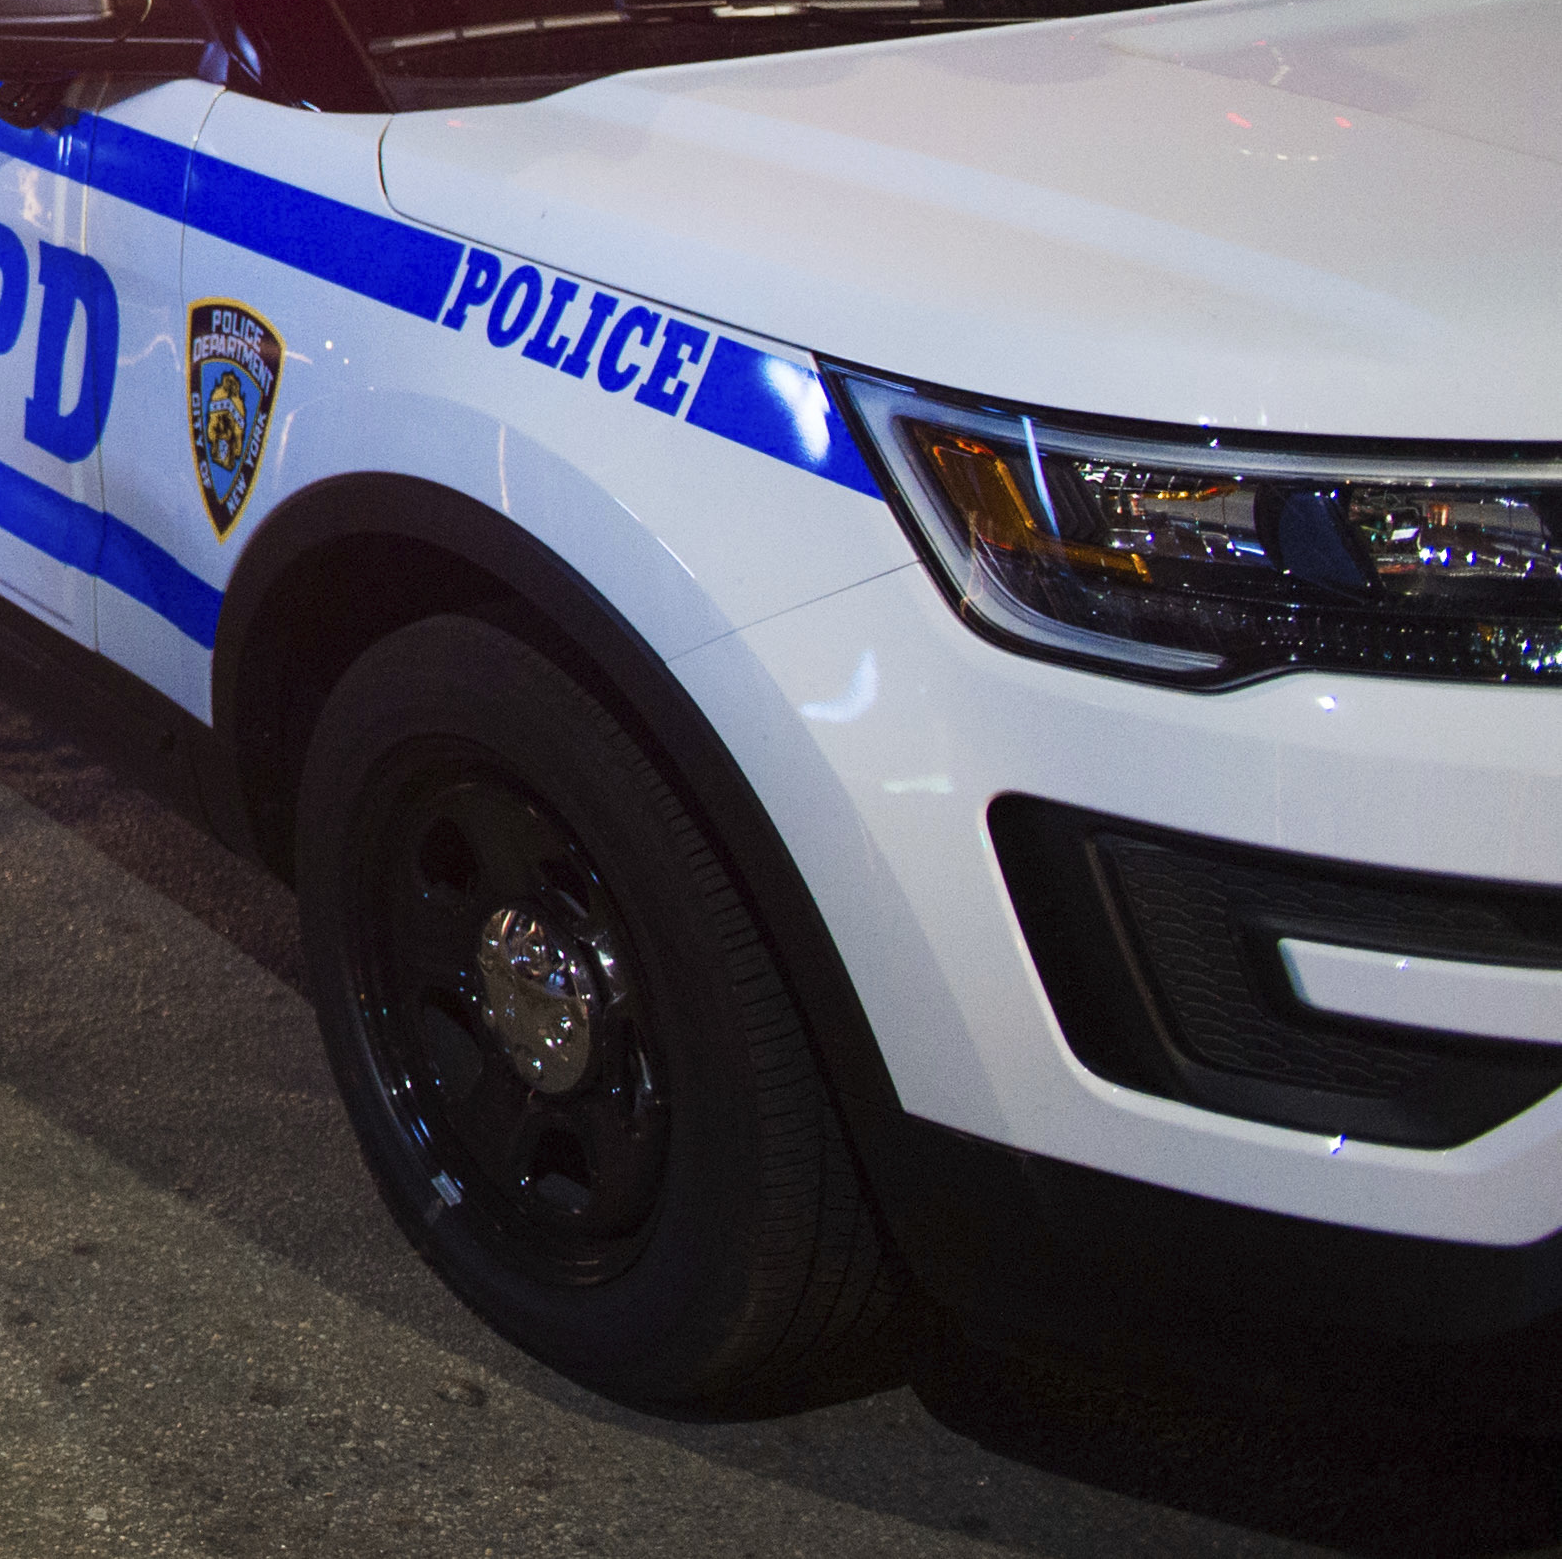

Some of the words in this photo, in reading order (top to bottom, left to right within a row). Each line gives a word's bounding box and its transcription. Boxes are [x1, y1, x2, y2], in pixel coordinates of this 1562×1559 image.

[192, 334, 274, 397] DEPARTMENT
[211, 309, 265, 355] POLICE
[441, 246, 711, 418] POLICE
[191, 392, 206, 448] CITY
[199, 459, 213, 489] OF
[226, 472, 248, 516] NEW
[244, 412, 268, 468] YORK
